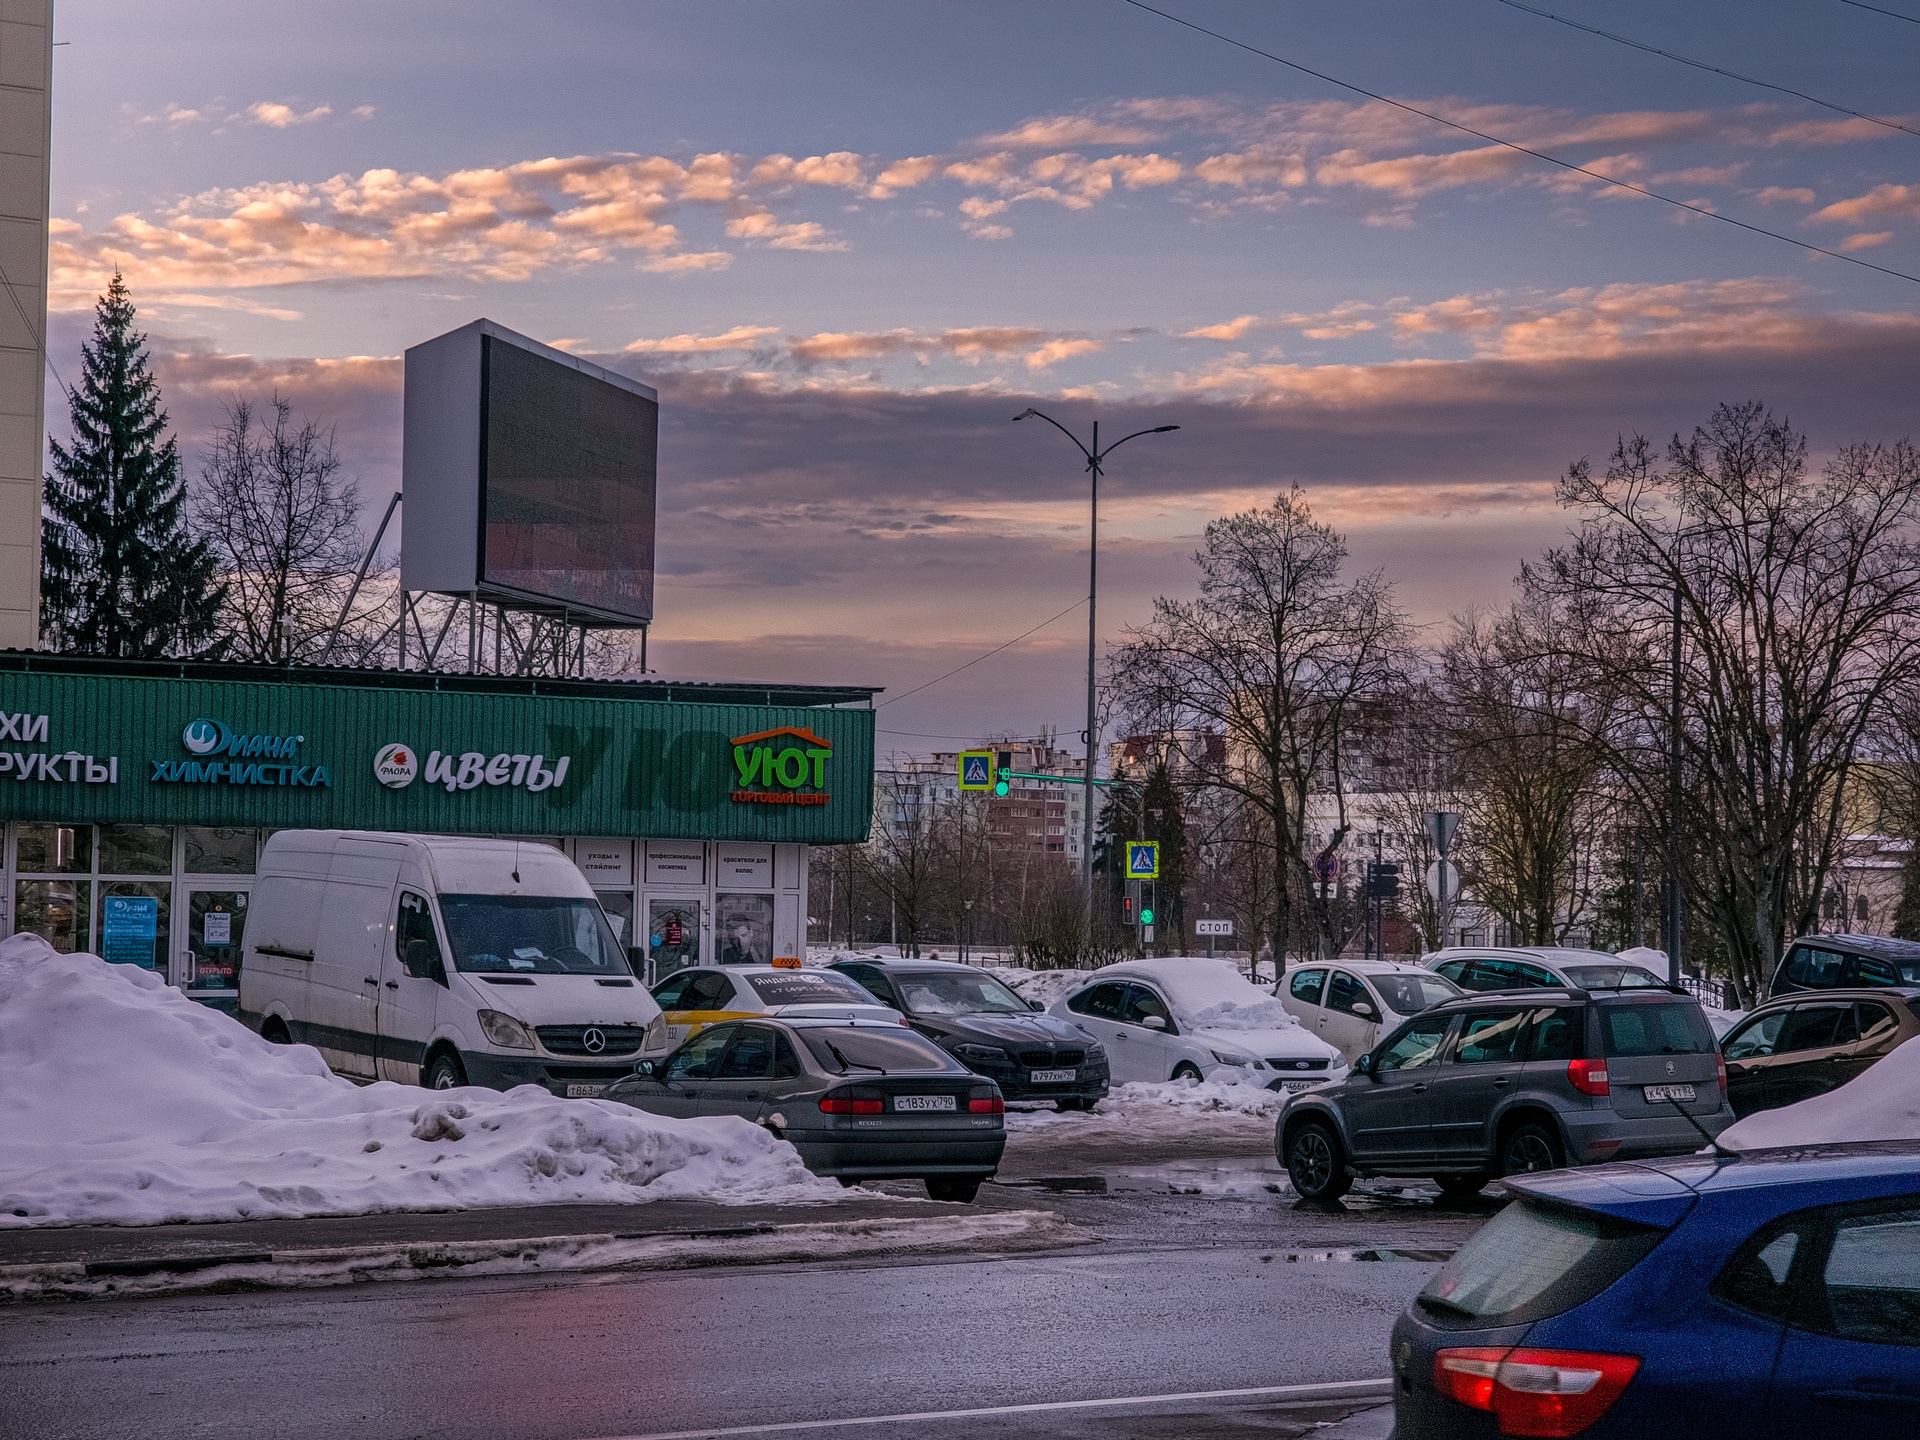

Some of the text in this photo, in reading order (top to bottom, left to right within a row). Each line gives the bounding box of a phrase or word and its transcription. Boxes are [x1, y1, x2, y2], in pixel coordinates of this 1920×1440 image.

[381, 767, 411, 776] ФЛОРА
[734, 746, 833, 788] УЮТ
[151, 760, 332, 787] ХИМЧИСТКА
[998, 768, 1010, 780] 48
[732, 791, 831, 806] ТОРГОВЫЙ ЦЕНТР
[1200, 923, 1229, 932] СТОП
[200, 967, 232, 975] ОТКРЫТО
[754, 975, 800, 986] Яндекс
[667, 1027, 677, 1040] 332
[938, 1096, 954, 1106] 790
